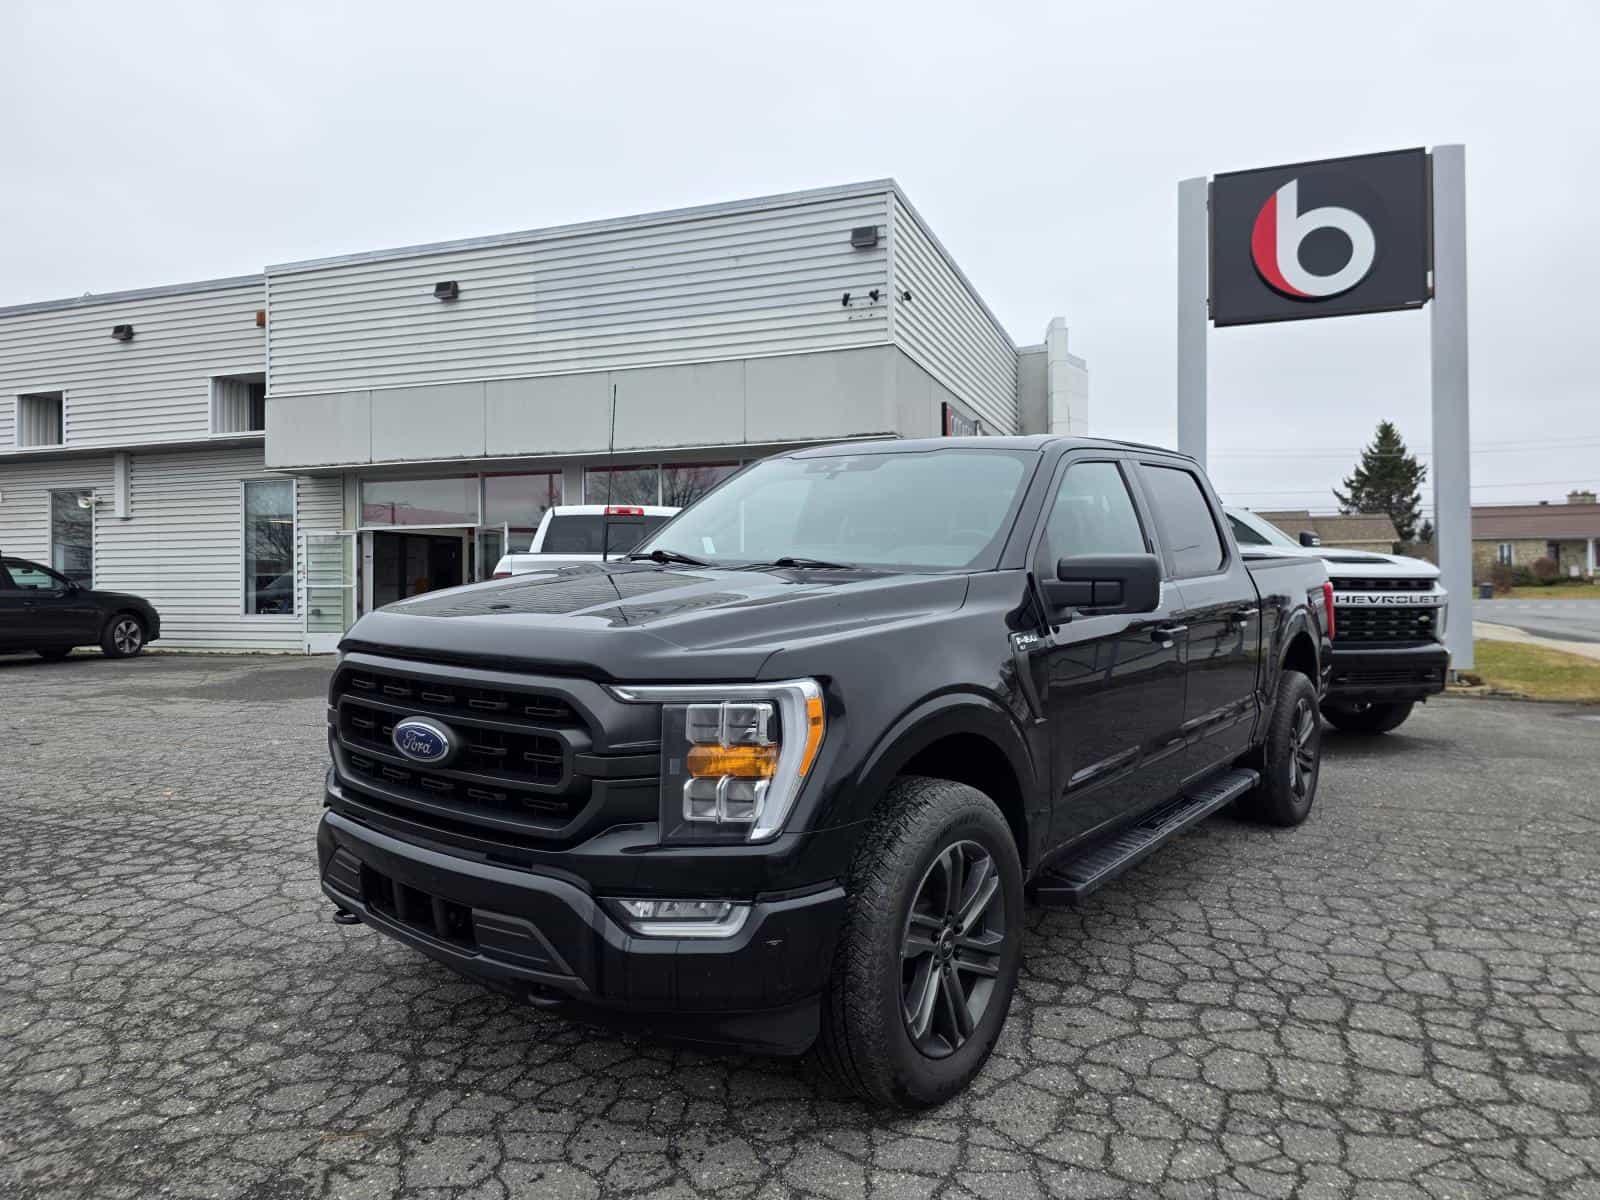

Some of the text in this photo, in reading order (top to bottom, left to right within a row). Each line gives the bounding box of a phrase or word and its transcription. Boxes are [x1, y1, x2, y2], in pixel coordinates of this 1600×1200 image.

[1275, 177, 1376, 297] b
[1335, 595, 1440, 604] HEVROLET
[402, 729, 433, 755] Ford
